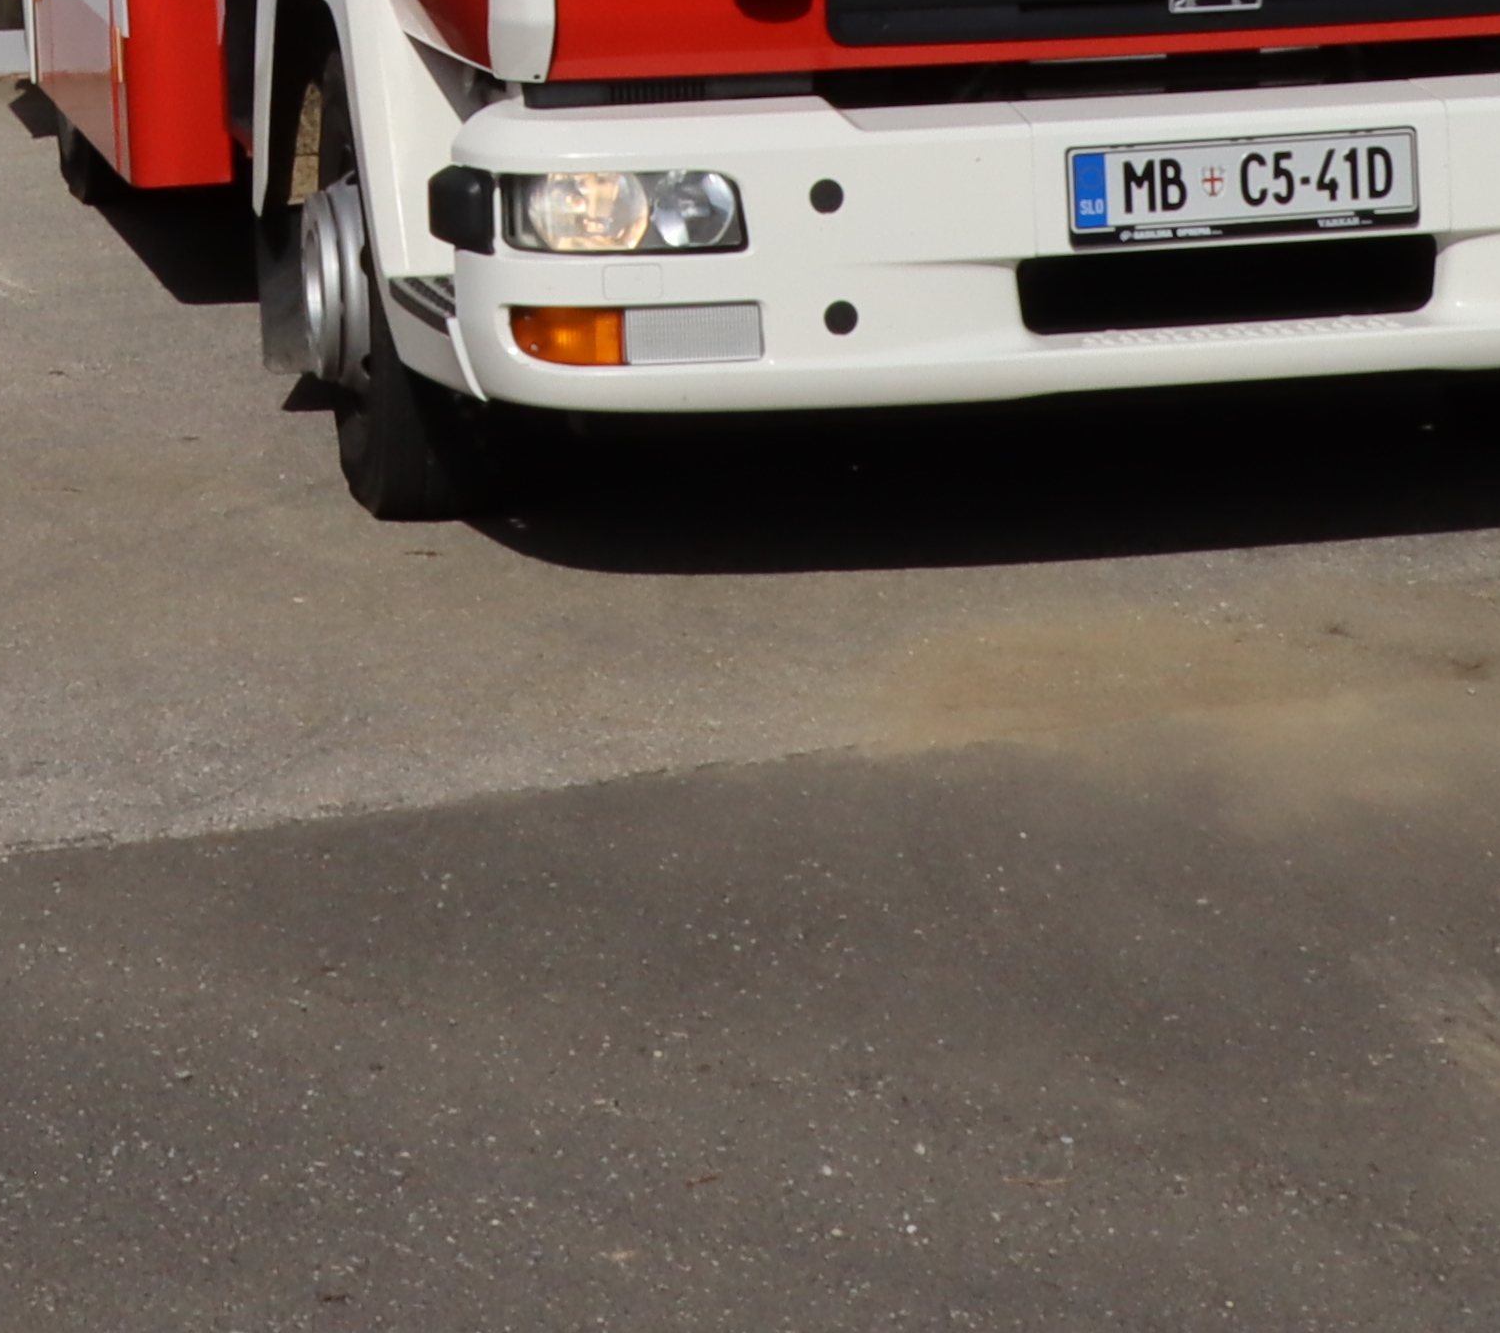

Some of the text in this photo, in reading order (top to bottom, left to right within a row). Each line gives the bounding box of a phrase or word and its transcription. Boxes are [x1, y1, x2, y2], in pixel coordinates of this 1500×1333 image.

[1123, 146, 1393, 214] MB C5-41D
[1079, 198, 1104, 215] SLO
